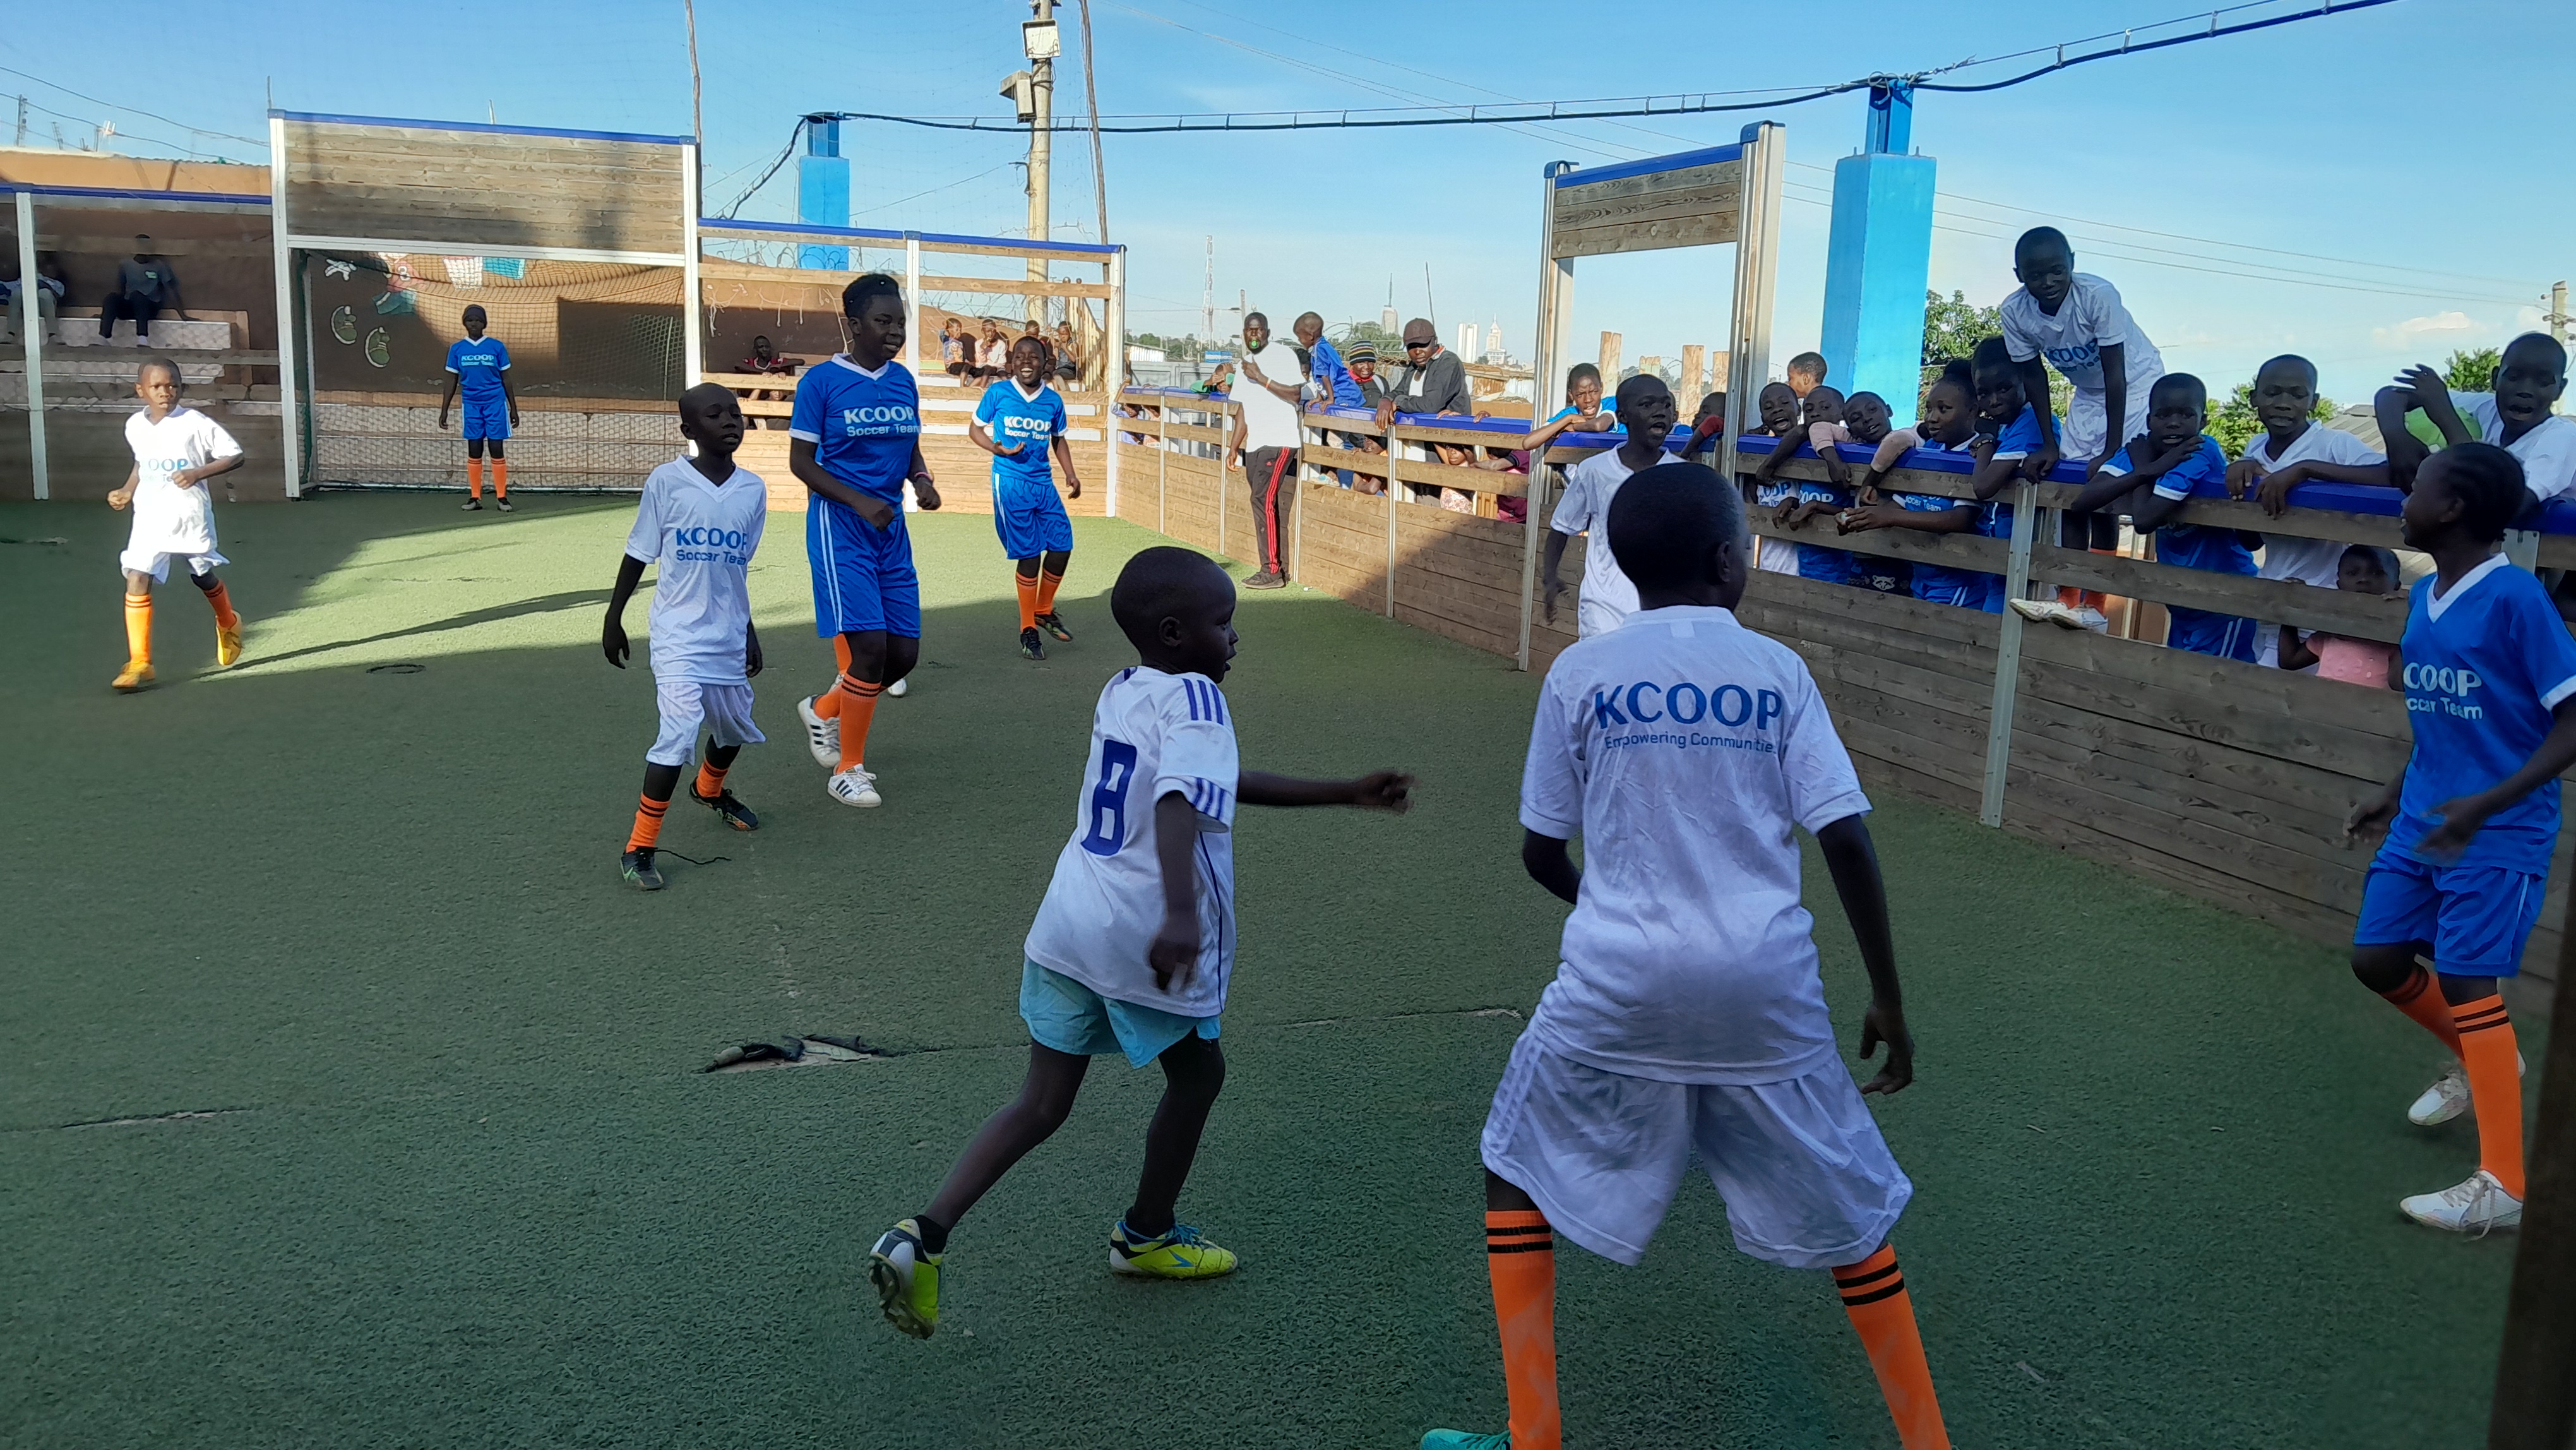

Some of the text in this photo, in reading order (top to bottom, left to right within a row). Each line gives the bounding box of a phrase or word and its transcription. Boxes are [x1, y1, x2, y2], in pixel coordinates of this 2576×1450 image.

[2047, 338, 2098, 362] COOP
[844, 405, 915, 424] KCOOP
[1003, 416, 1052, 432] KCOOP
[846, 426, 891, 437] Soccer
[148, 458, 188, 472] OOP
[1799, 490, 1834, 504] OOP
[676, 549, 720, 561] Soccer
[2403, 662, 2483, 697] COOP
[1595, 681, 1782, 730] KCOOP
[2406, 697, 2483, 720] ccer Team
[1604, 731, 1777, 754] Empowering Communitie
